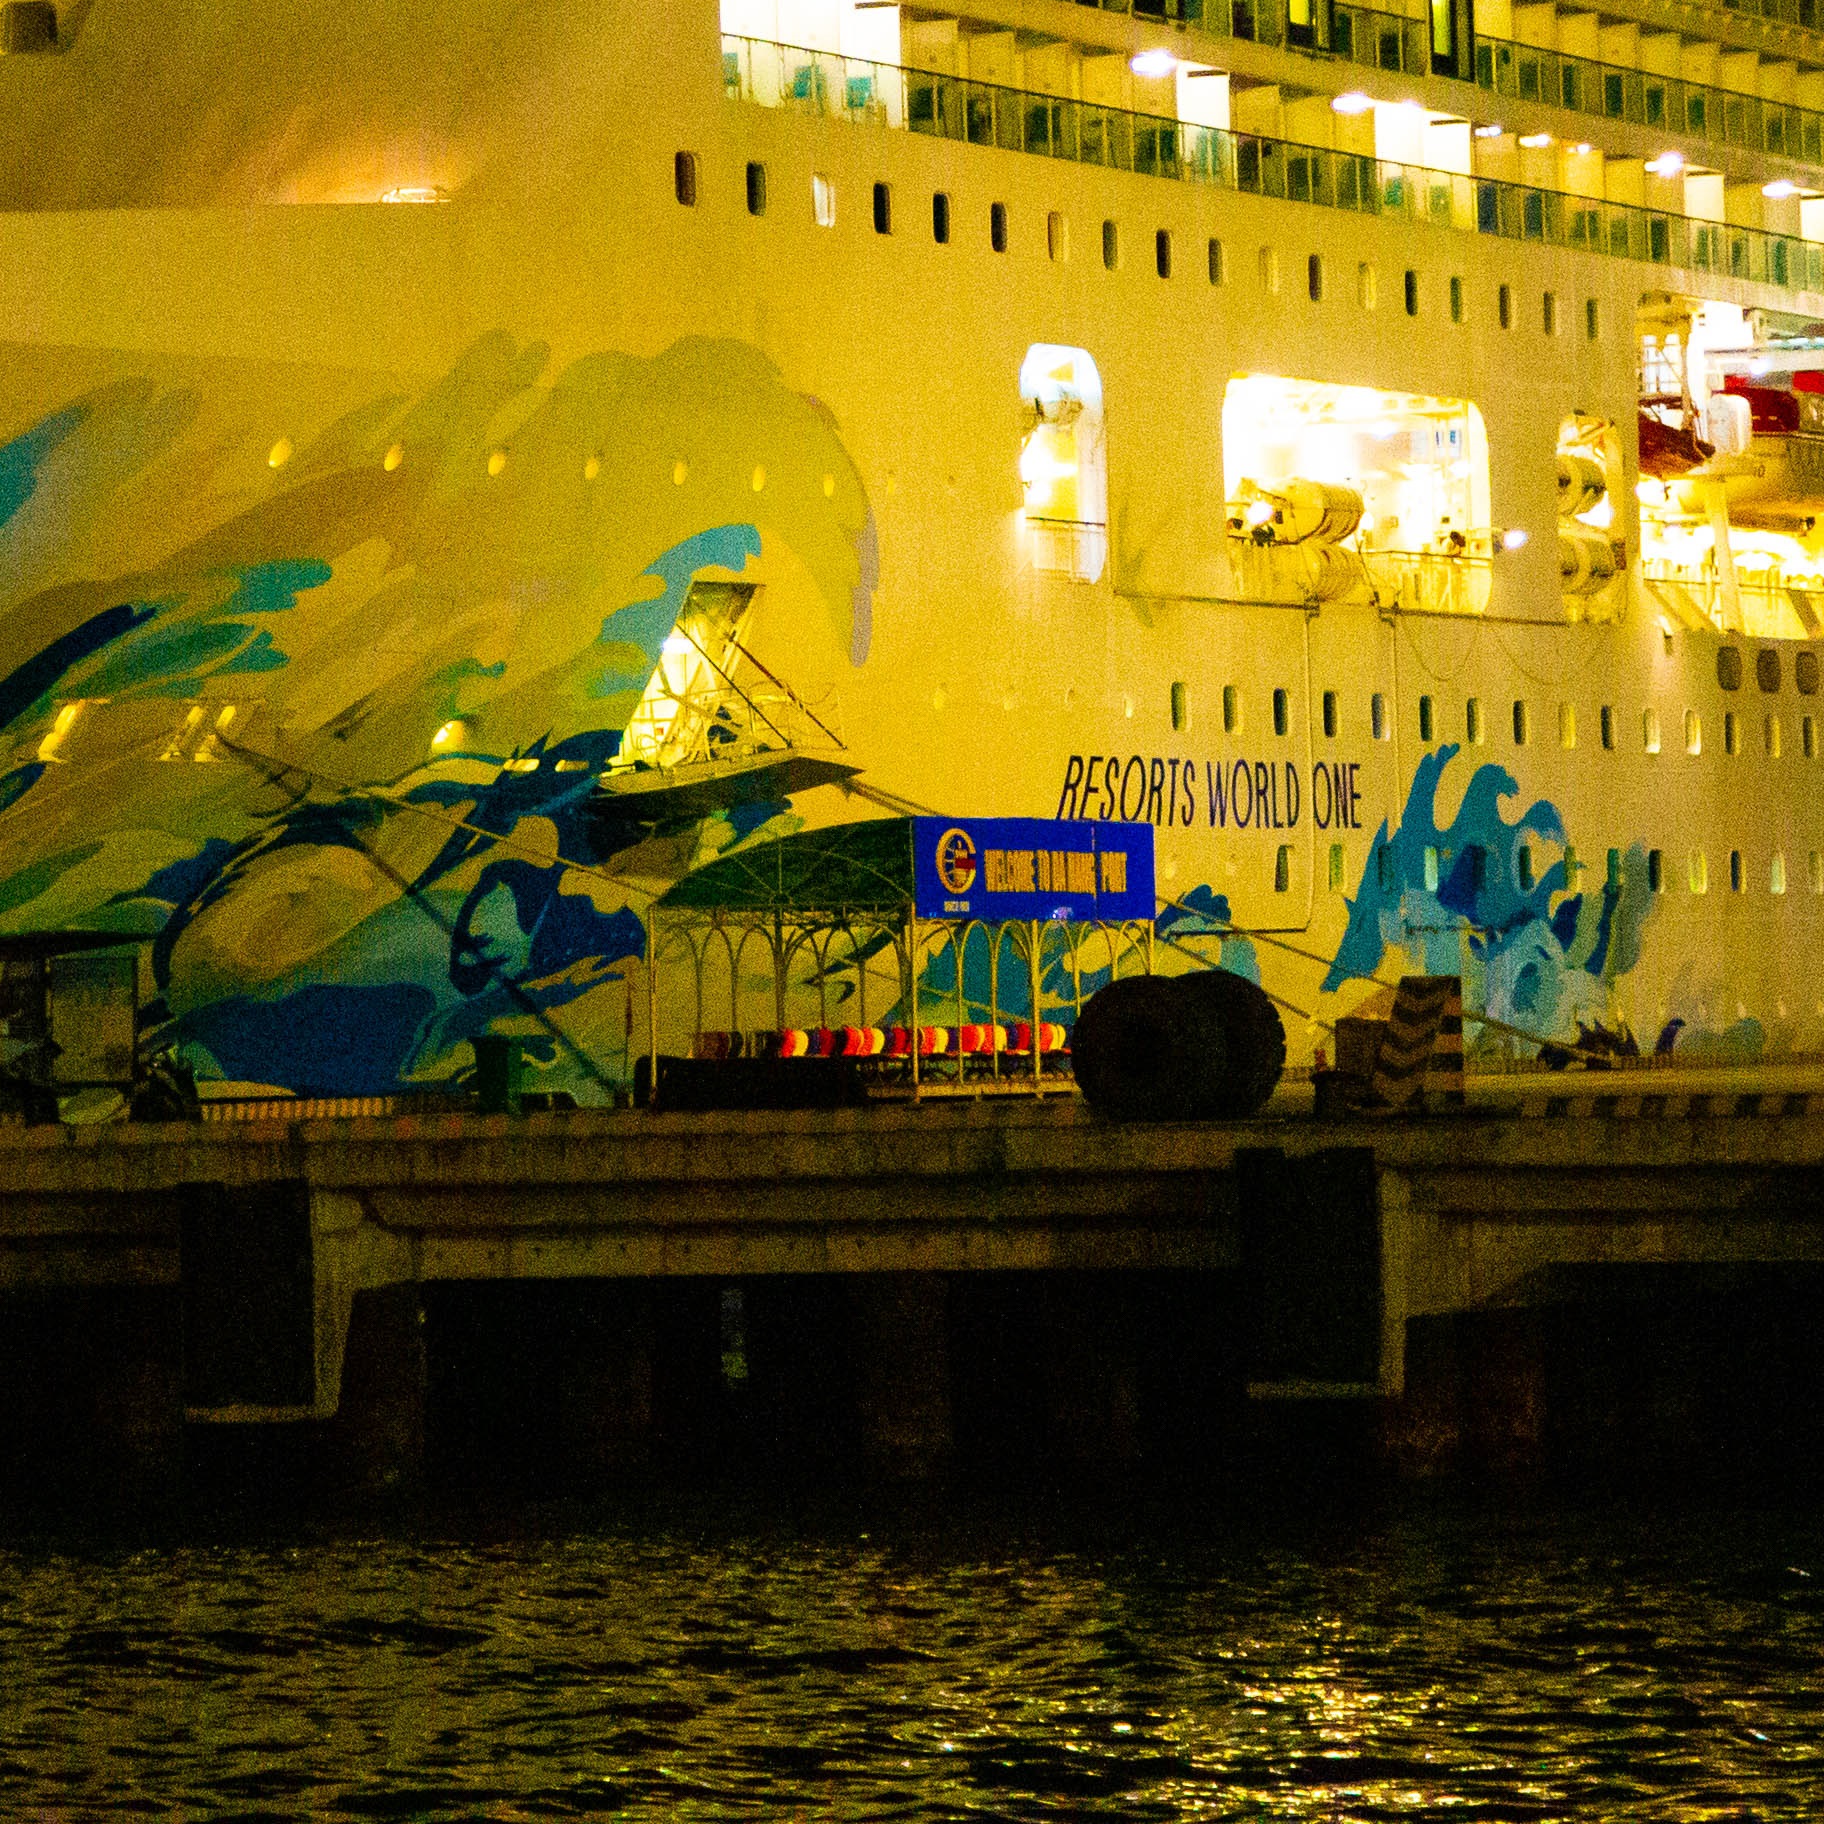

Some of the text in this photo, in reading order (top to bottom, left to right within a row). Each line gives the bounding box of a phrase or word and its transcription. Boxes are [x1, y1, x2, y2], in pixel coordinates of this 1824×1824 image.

[1055, 754, 1363, 830] RESORTS WORLD ONE
